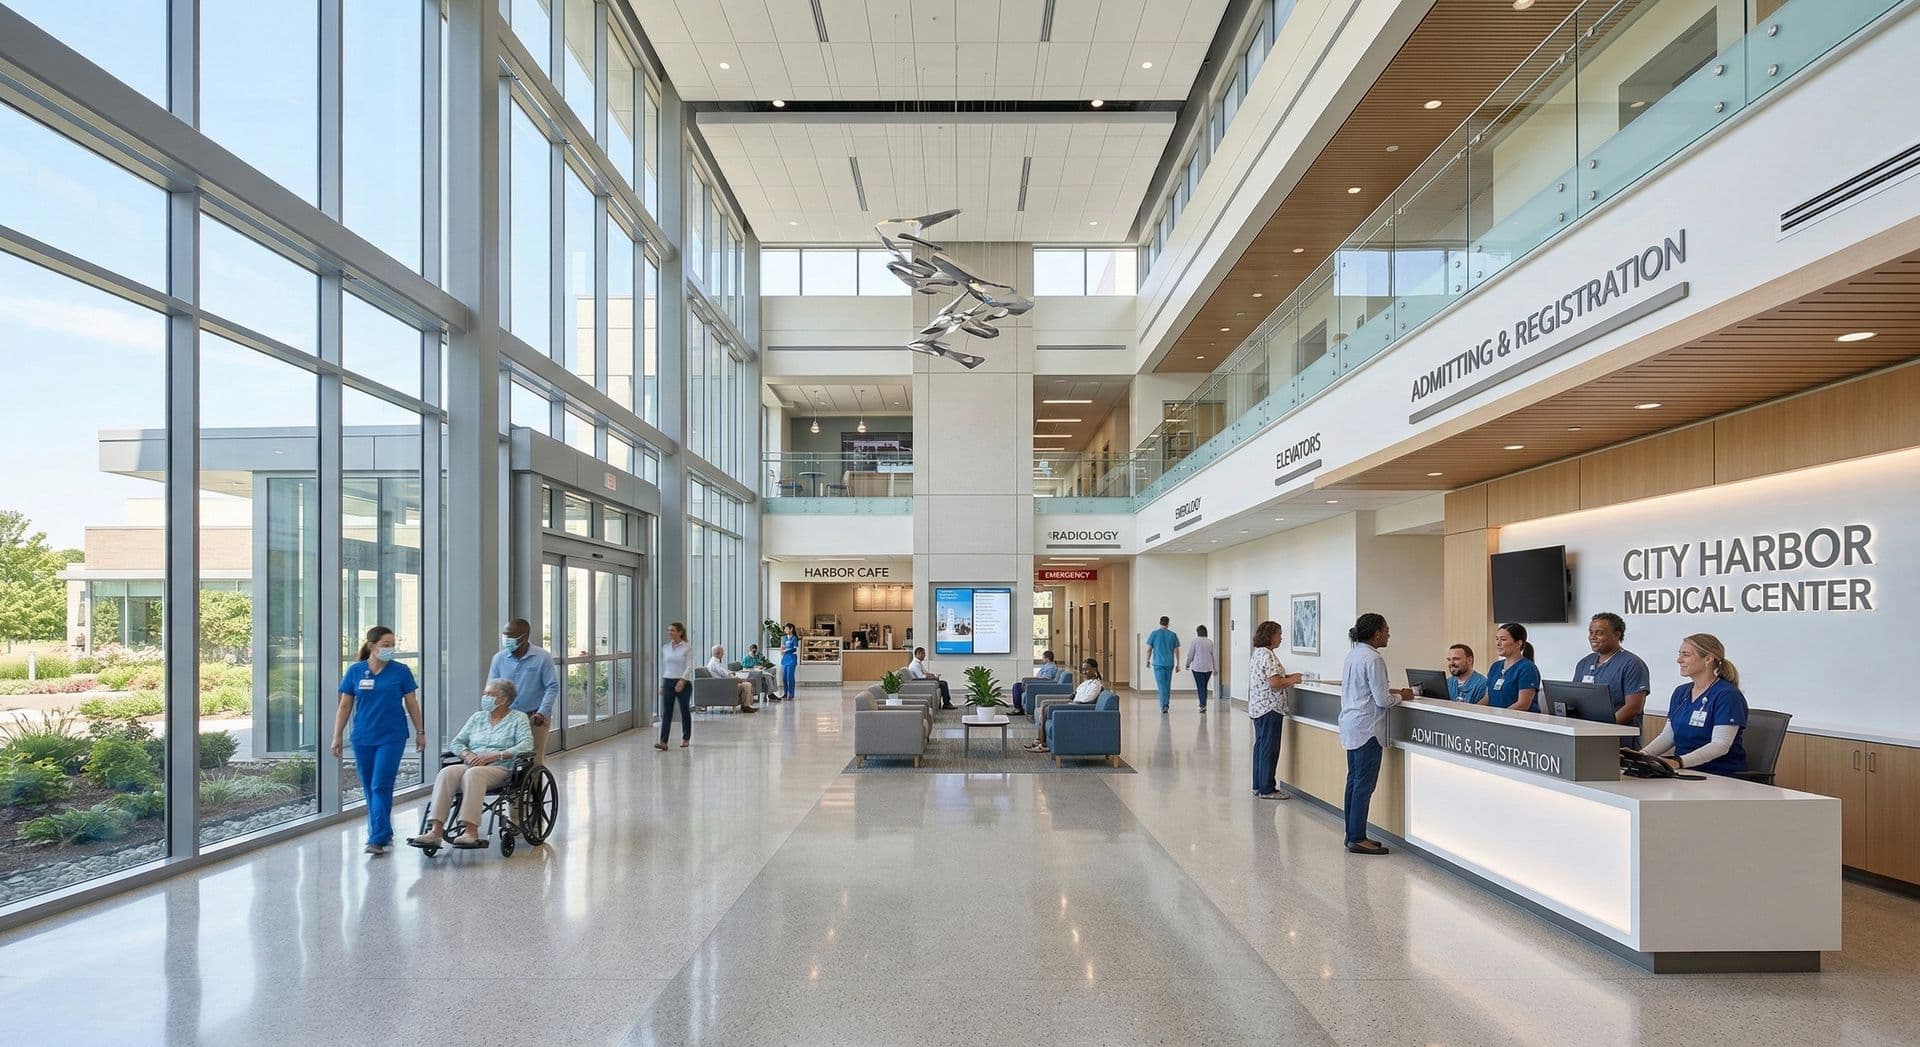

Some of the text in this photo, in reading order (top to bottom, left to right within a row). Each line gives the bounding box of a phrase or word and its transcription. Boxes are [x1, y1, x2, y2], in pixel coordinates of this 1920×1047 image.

[1411, 229, 1686, 402] ADMITTING & REGISTRATION
[1276, 432, 1321, 469] ELEVATORS
[1052, 531, 1119, 541] RADIOLOGY
[1623, 524, 1873, 581] CITY HARBOR
[804, 567, 890, 578] HARBOR CAFE
[1044, 571, 1091, 579] EMERGENCY
[1624, 578, 1873, 614] MEDICAL CENTER
[1411, 728, 1462, 751] ADMITTING
[1464, 738, 1472, 754] &
